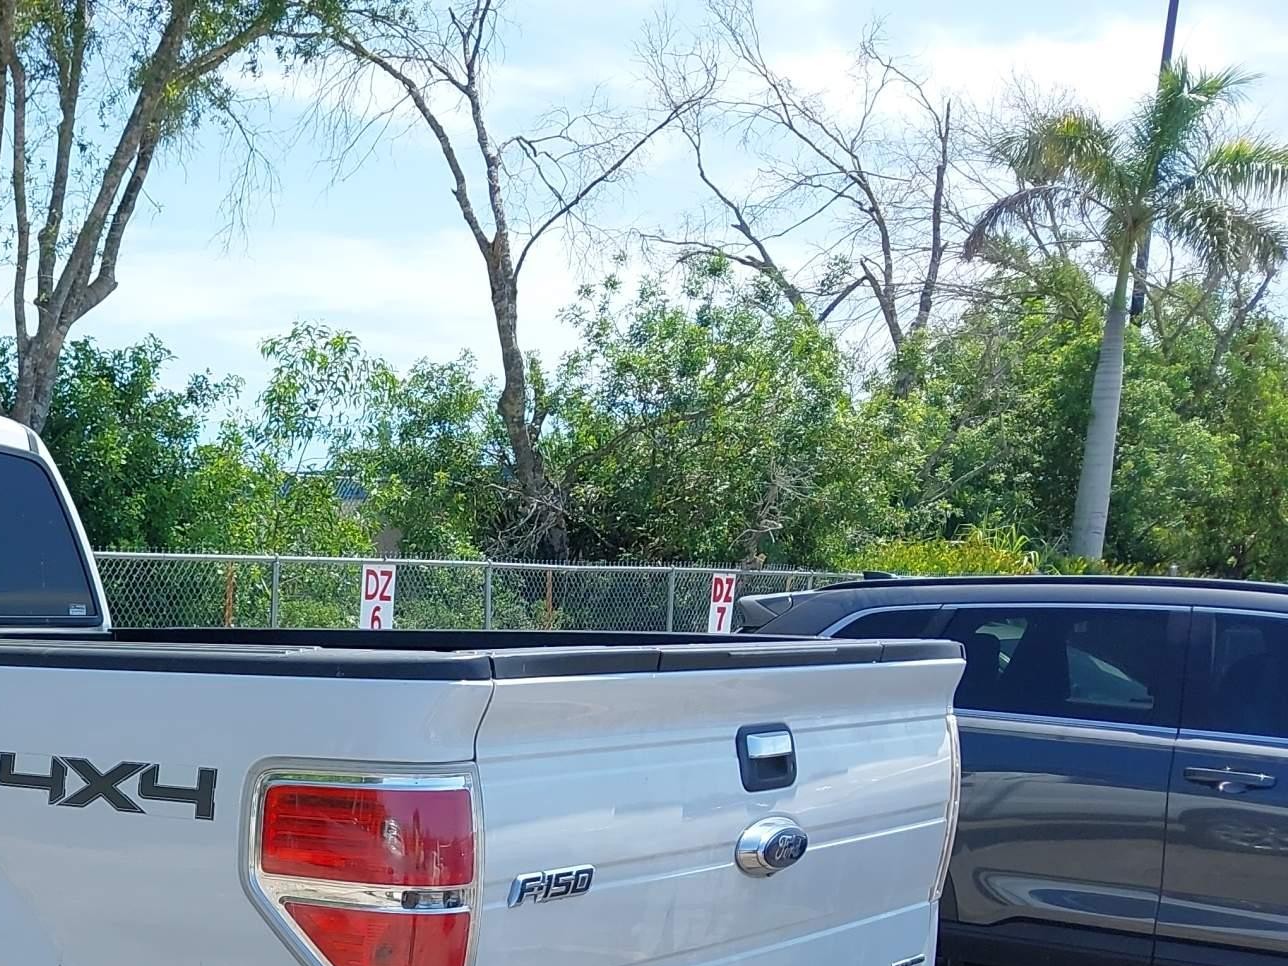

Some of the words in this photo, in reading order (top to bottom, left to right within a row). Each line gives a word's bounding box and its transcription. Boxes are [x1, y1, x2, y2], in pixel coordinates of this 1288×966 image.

[364, 568, 392, 602] DZ
[712, 577, 734, 603] DZ
[370, 605, 382, 630] 6
[716, 606, 726, 631] 7
